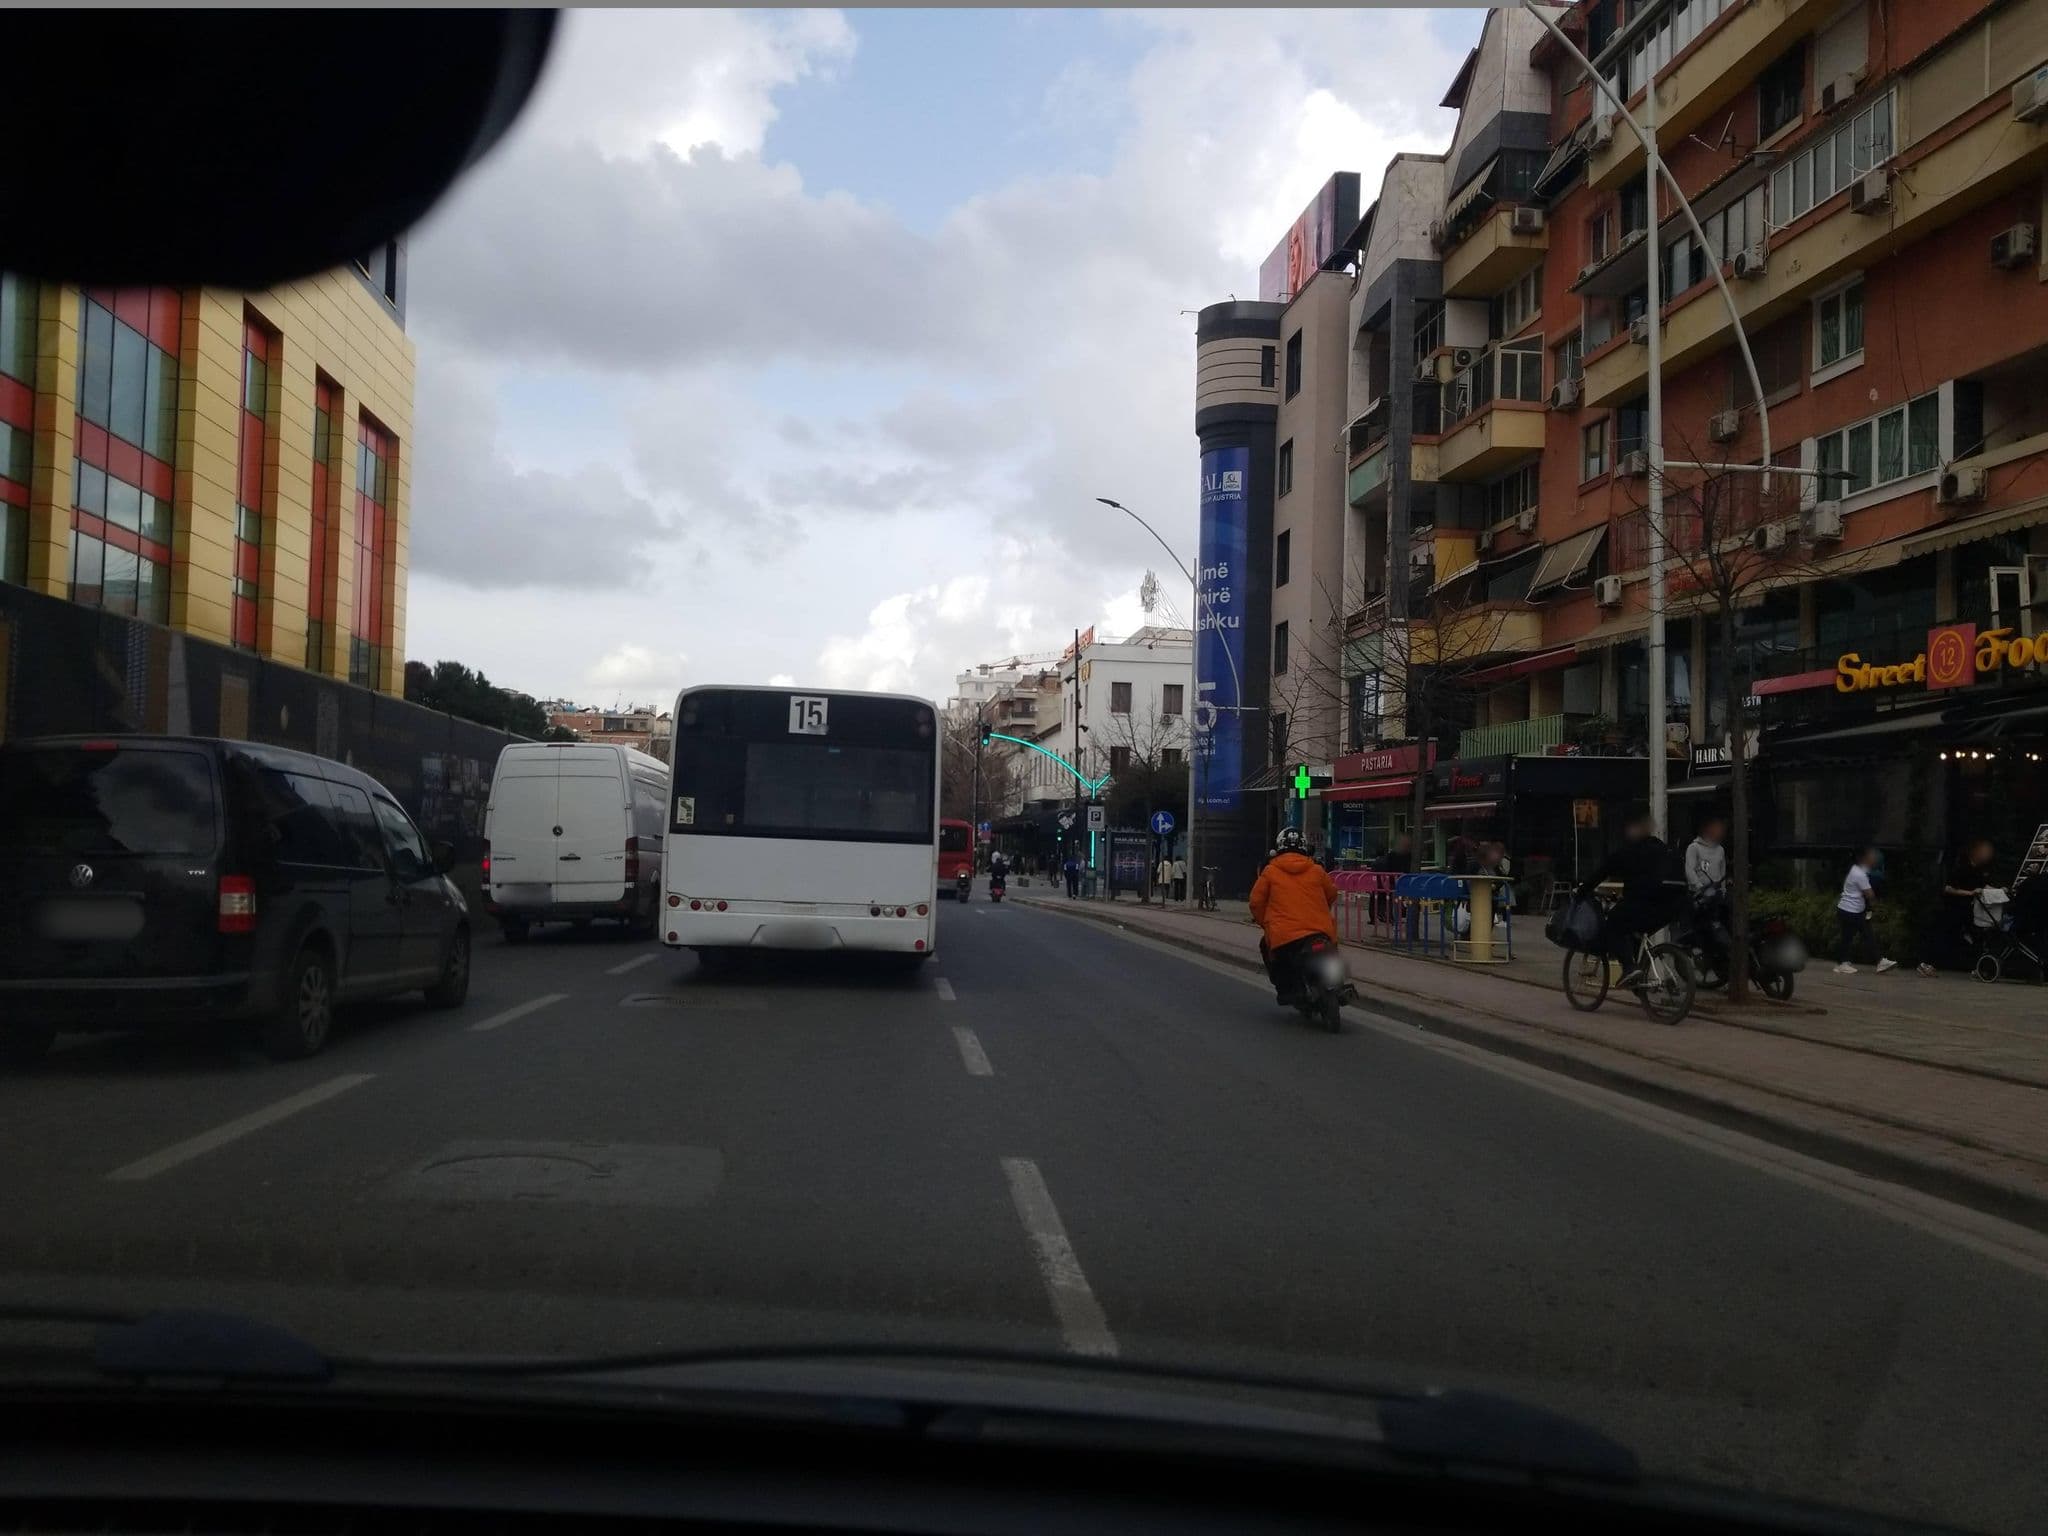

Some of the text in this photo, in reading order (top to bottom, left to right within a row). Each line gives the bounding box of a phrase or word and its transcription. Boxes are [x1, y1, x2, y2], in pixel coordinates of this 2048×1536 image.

[1836, 627, 2048, 693] Street 12 Foo
[794, 700, 823, 729] 15
[1361, 755, 1392, 771] PASTARIA
[1696, 748, 1718, 764] HAIR
